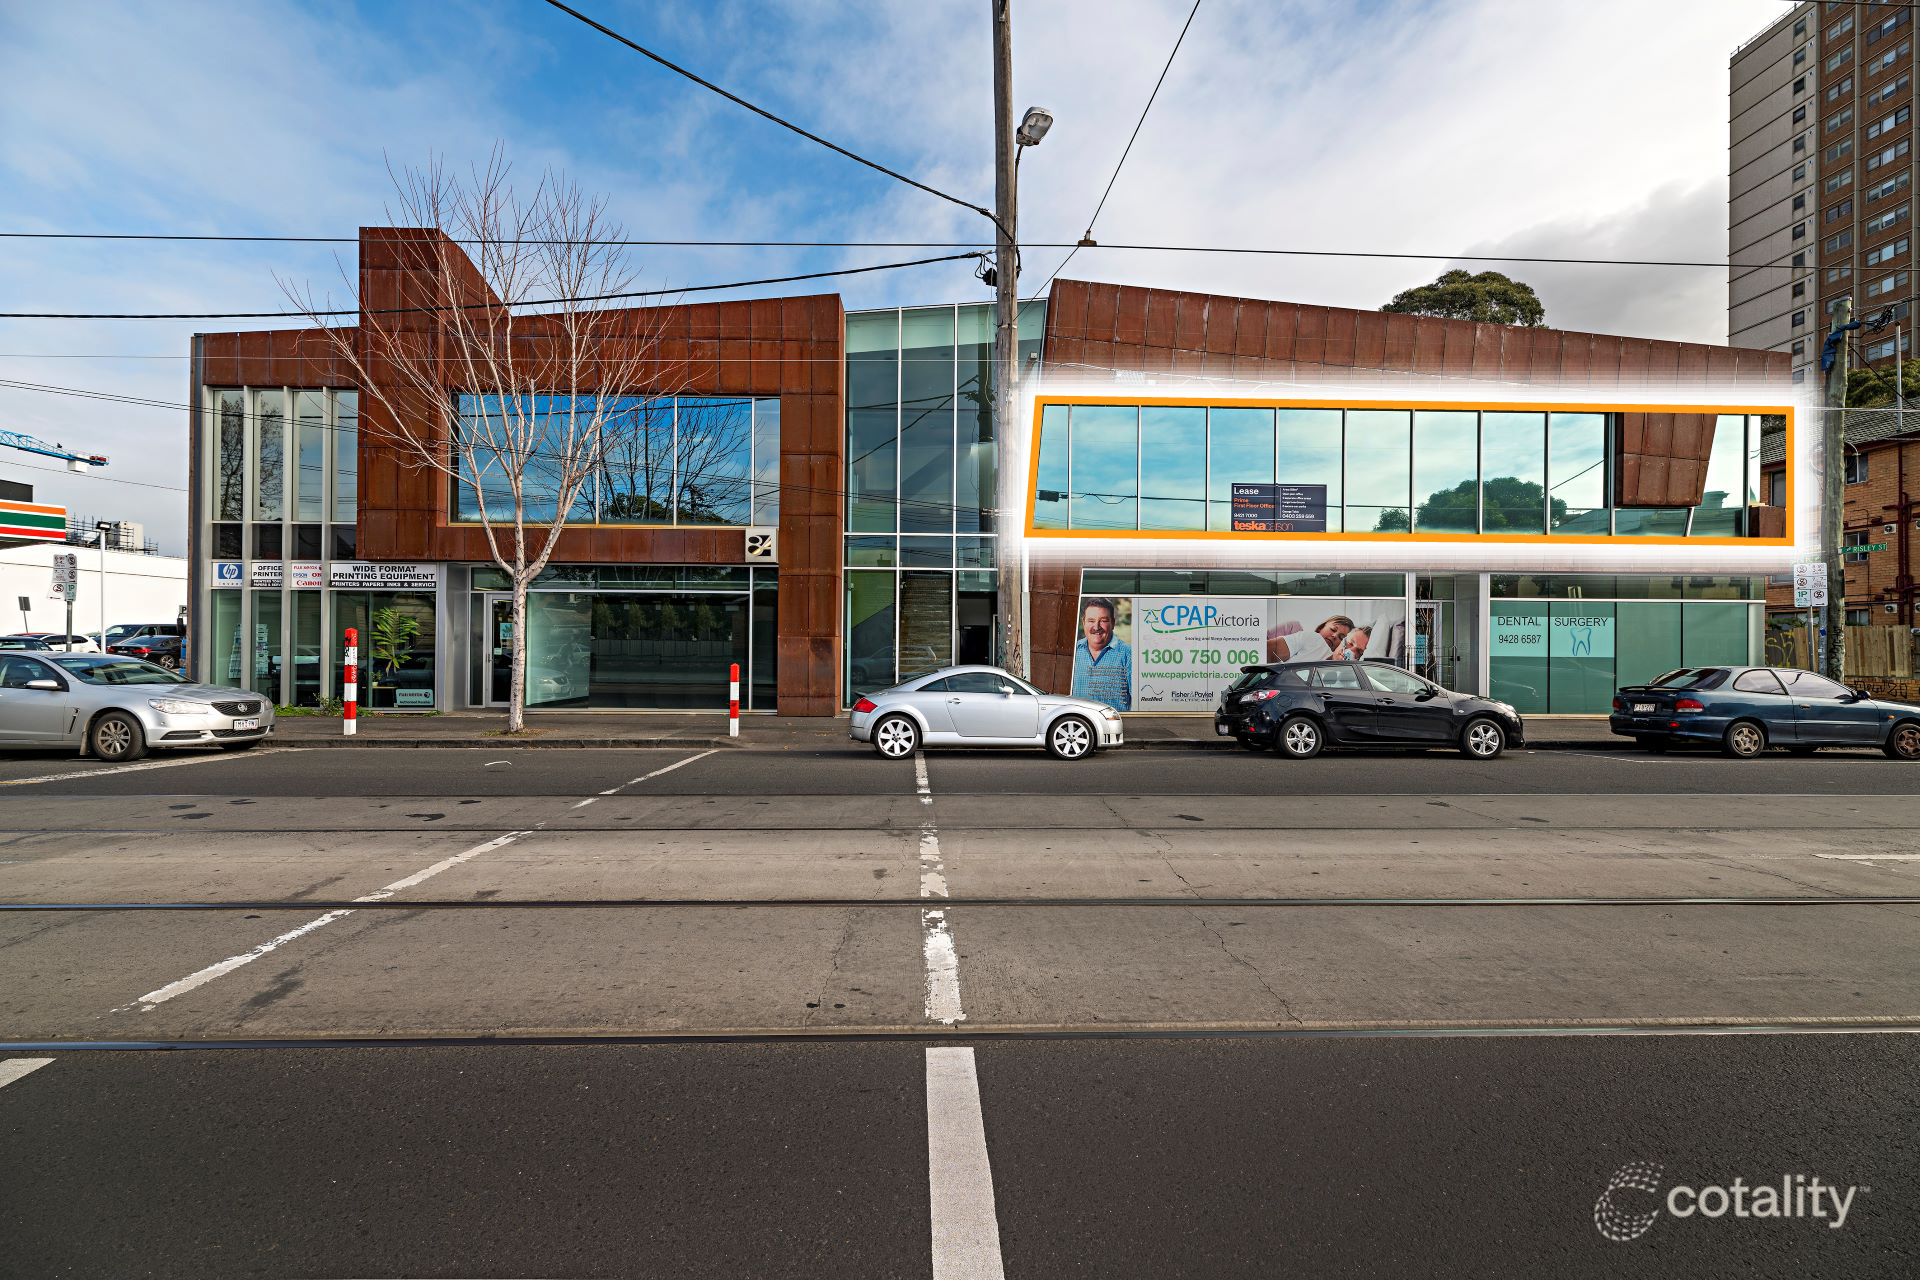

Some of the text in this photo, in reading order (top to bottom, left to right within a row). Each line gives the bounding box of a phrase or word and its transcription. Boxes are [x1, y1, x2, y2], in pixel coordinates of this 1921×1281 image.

[226, 564, 236, 579] hp
[1498, 617, 1608, 626] DENTAL SURGERY
[1498, 635, 1541, 644] 9428 6587
[1142, 649, 1259, 664] 1300 750 006
